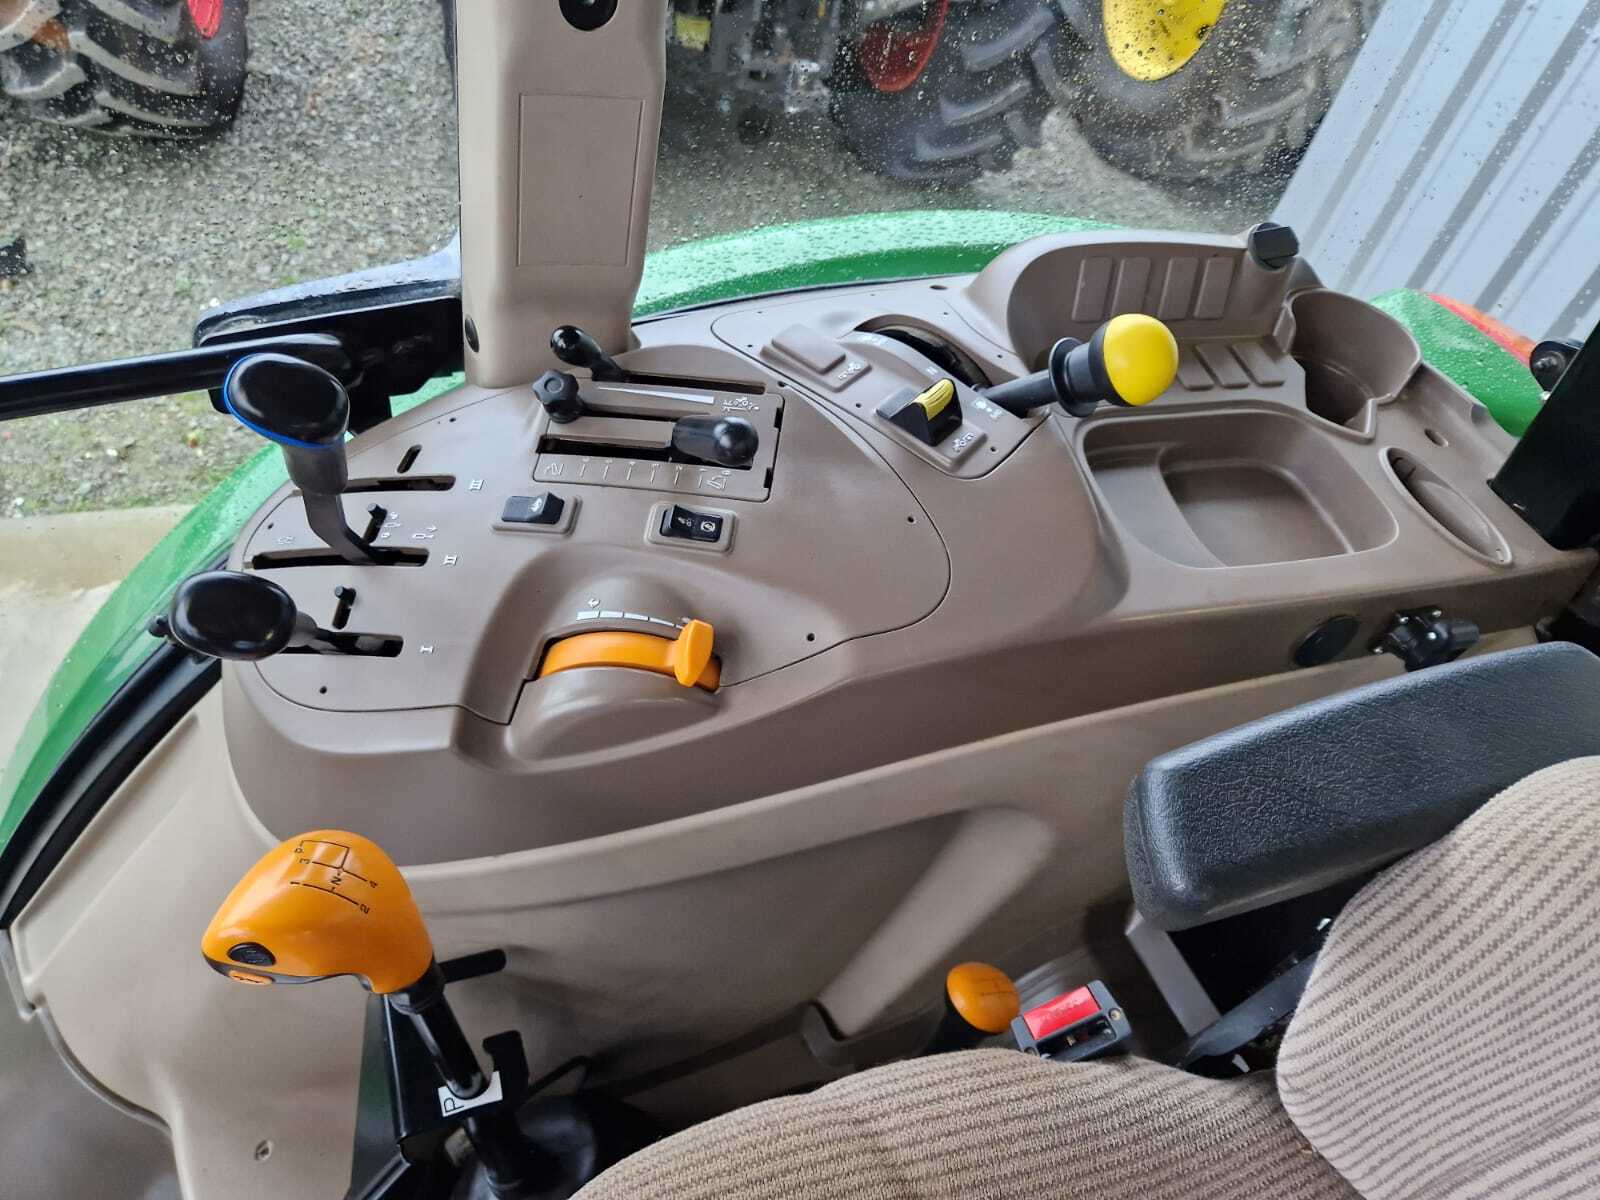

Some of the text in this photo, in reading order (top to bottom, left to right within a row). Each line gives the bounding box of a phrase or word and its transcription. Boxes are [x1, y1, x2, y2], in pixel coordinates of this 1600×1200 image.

[330, 875, 342, 886] N
[369, 880, 378, 889] 4
[359, 903, 370, 914] 2
[443, 1097, 464, 1113] P
